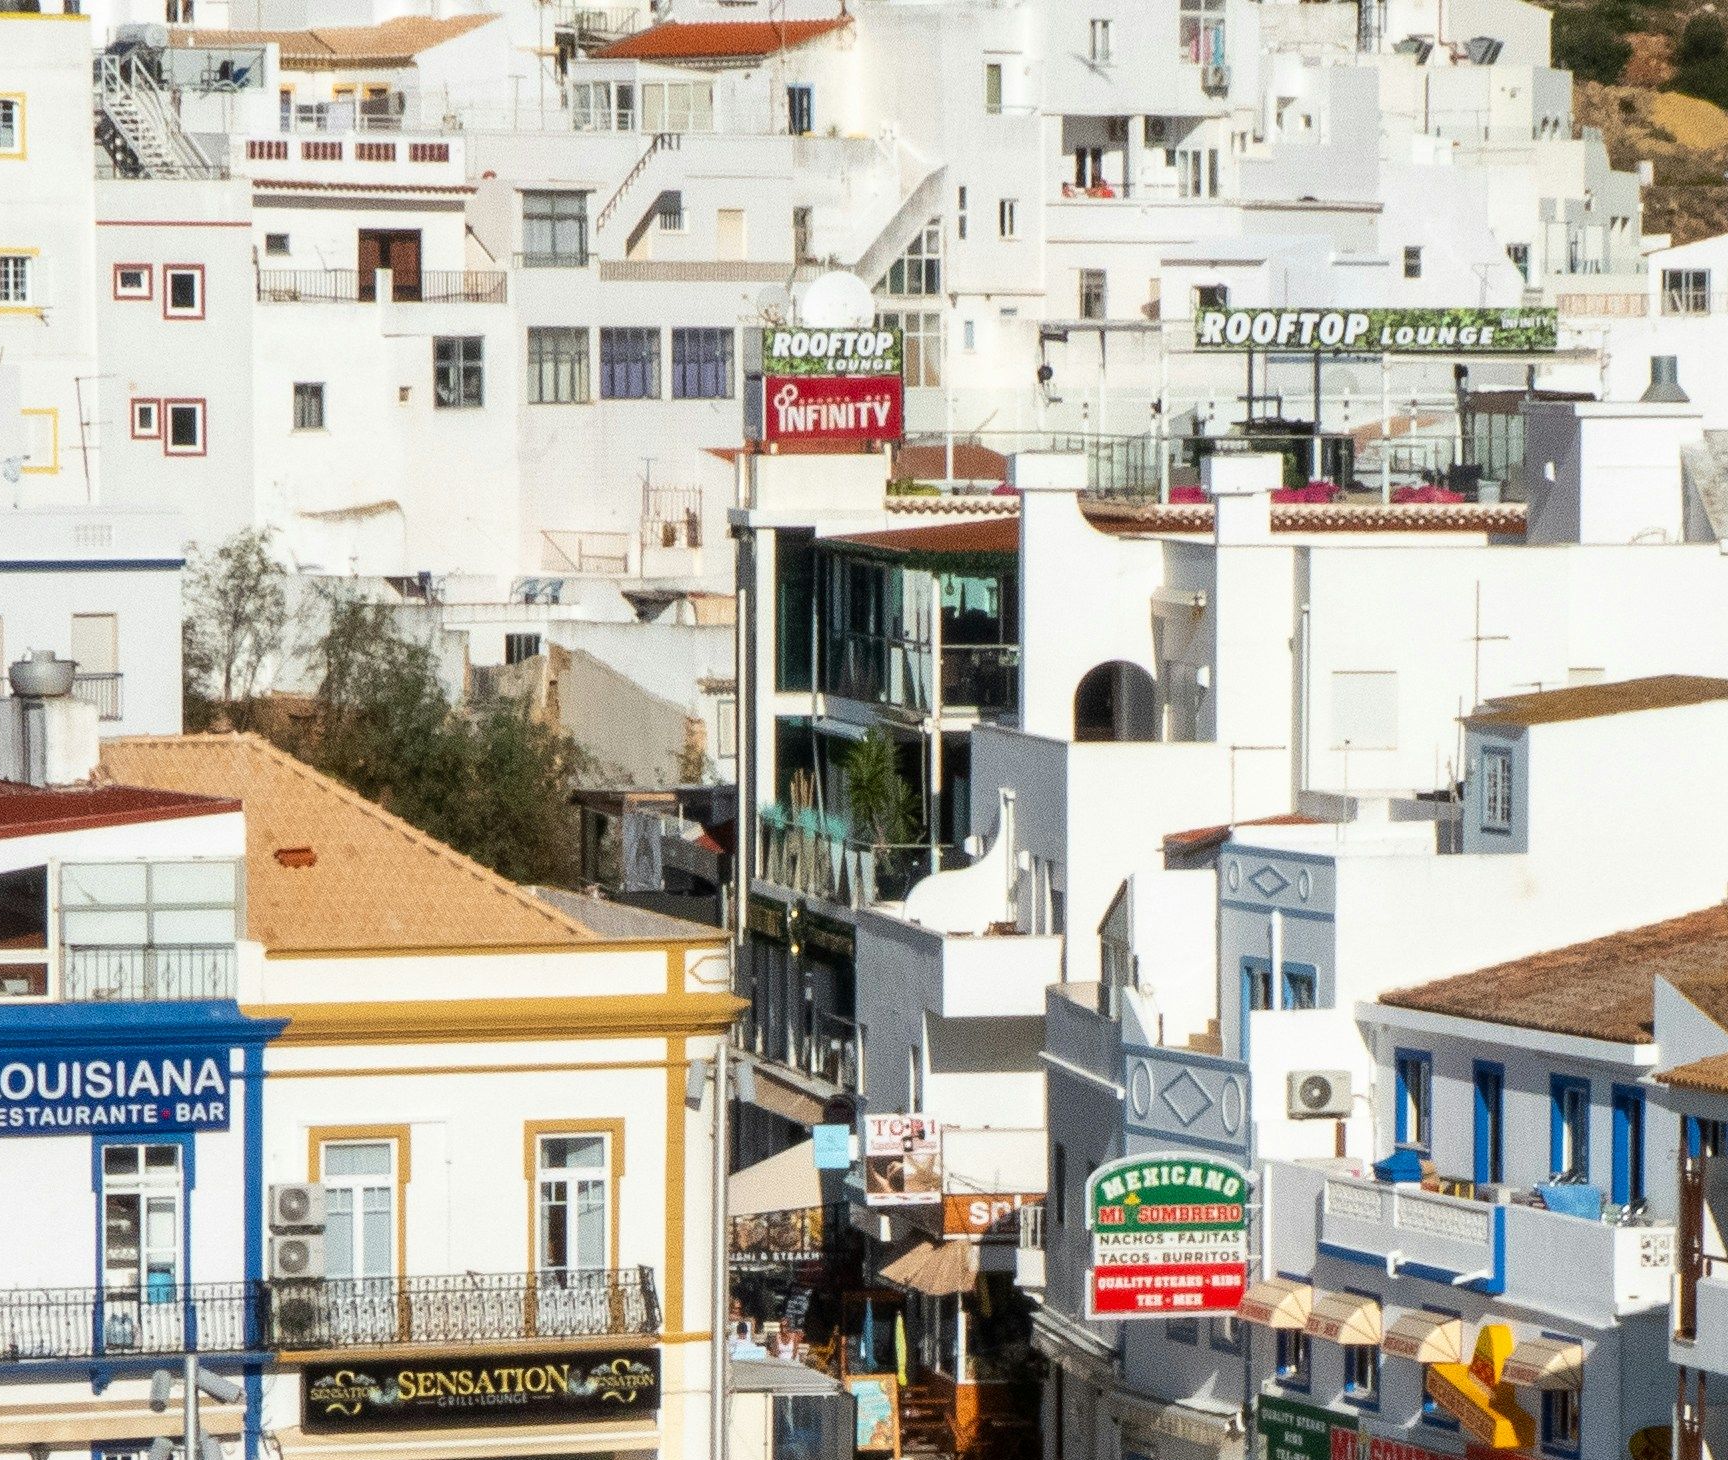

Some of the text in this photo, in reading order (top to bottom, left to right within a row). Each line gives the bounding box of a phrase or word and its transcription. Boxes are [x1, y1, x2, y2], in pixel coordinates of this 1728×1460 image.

[1201, 312, 1496, 346] ROOFTOP LOUNGE
[772, 332, 893, 357] ROOFTOP
[827, 359, 892, 371] LOUNGE
[774, 398, 891, 432] INFINITY
[175, 1101, 225, 1124] BAR
[1100, 1165, 1241, 1201] MEXICANO
[1098, 1203, 1243, 1225] MI SOMBRERO
[1099, 1231, 1241, 1246] NACHOS FAJITAS
[1099, 1250, 1241, 1265] TACOS BURRITOS
[1098, 1273, 1242, 1290] QUALITY STEAKS RIBS
[397, 1363, 571, 1400] SENSATION
